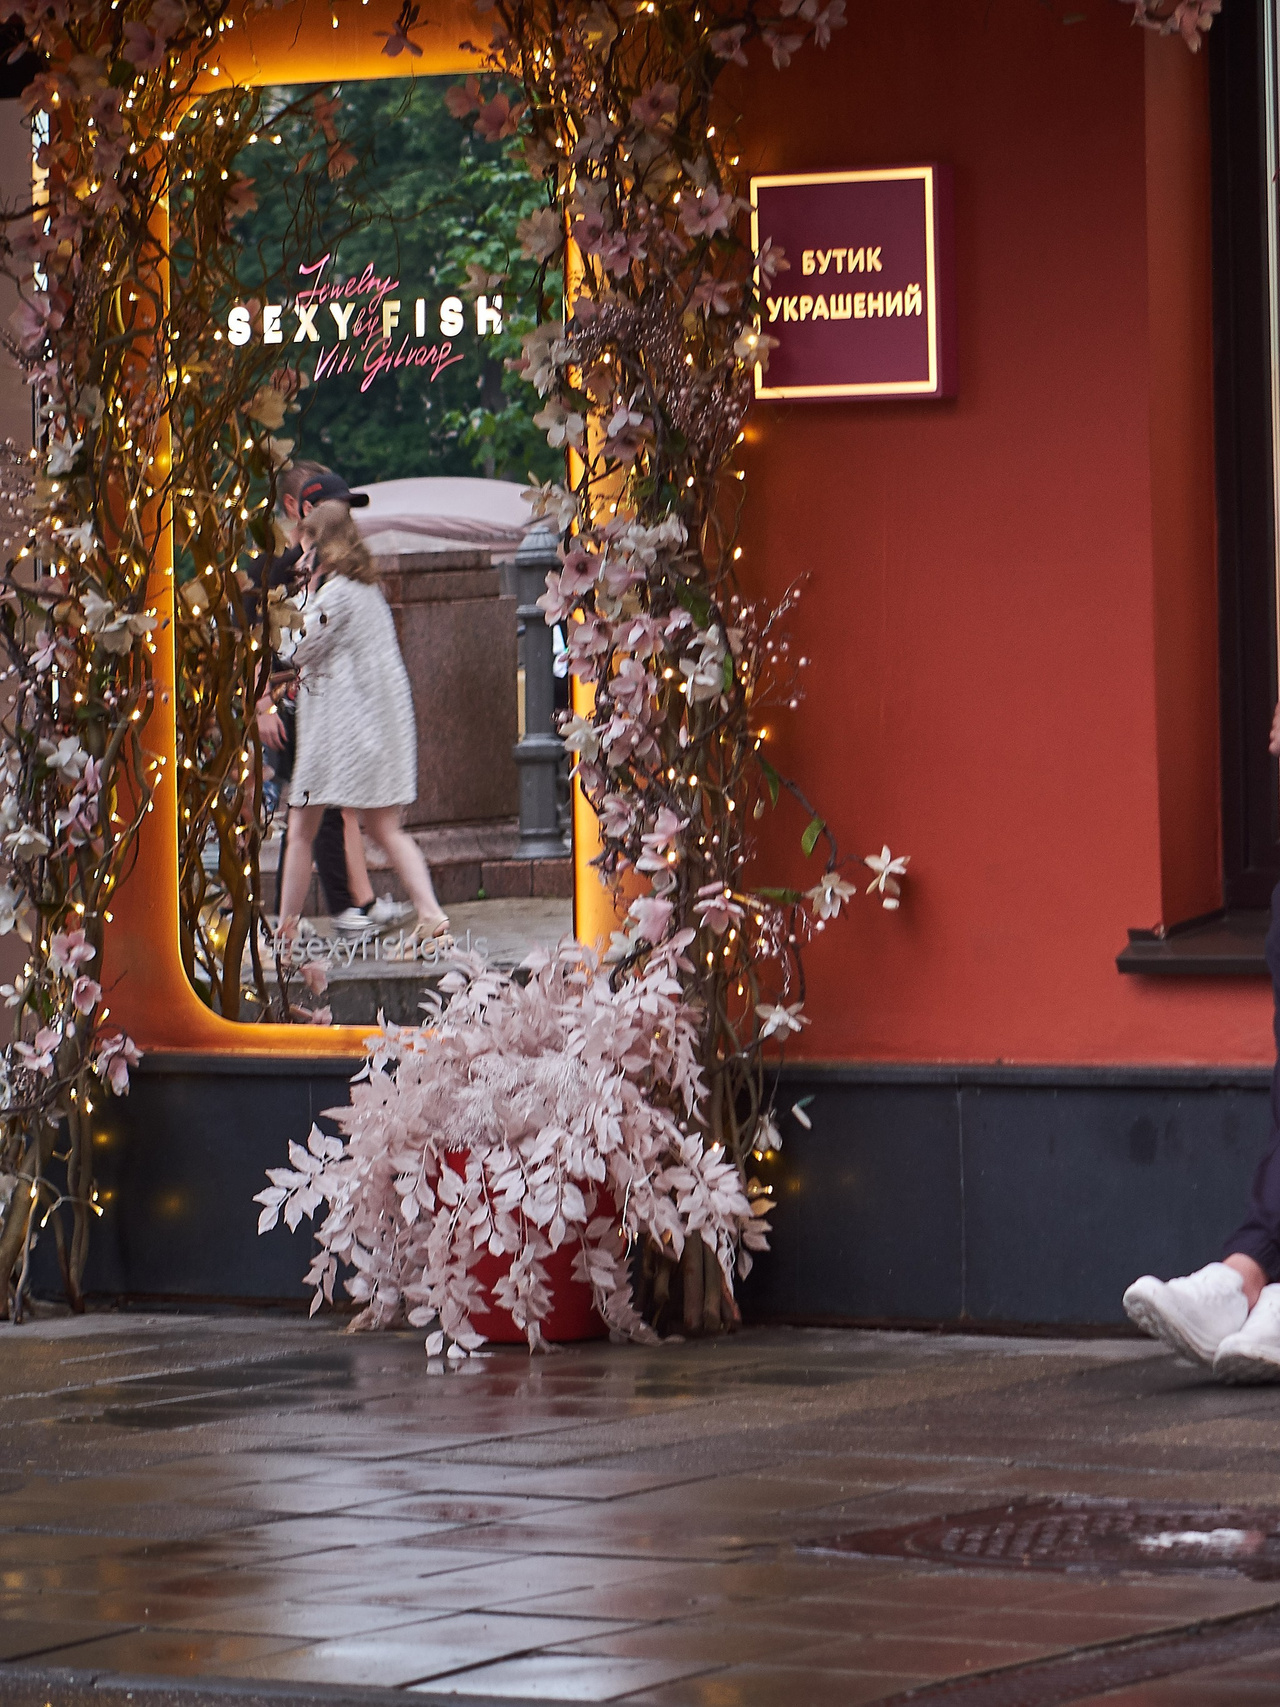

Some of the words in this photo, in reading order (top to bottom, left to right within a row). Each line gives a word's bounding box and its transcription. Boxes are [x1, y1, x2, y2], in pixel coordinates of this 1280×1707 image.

[802, 246, 883, 276] БУТИК
[295, 252, 400, 315] Jewelry
[766, 283, 922, 323] УКРАШЕНИЙ
[227, 301, 356, 346] SEXY
[382, 294, 503, 338] FISH
[352, 306, 383, 351] by
[313, 342, 357, 382] Viki
[270, 928, 489, 969] #sexyfishgirls
